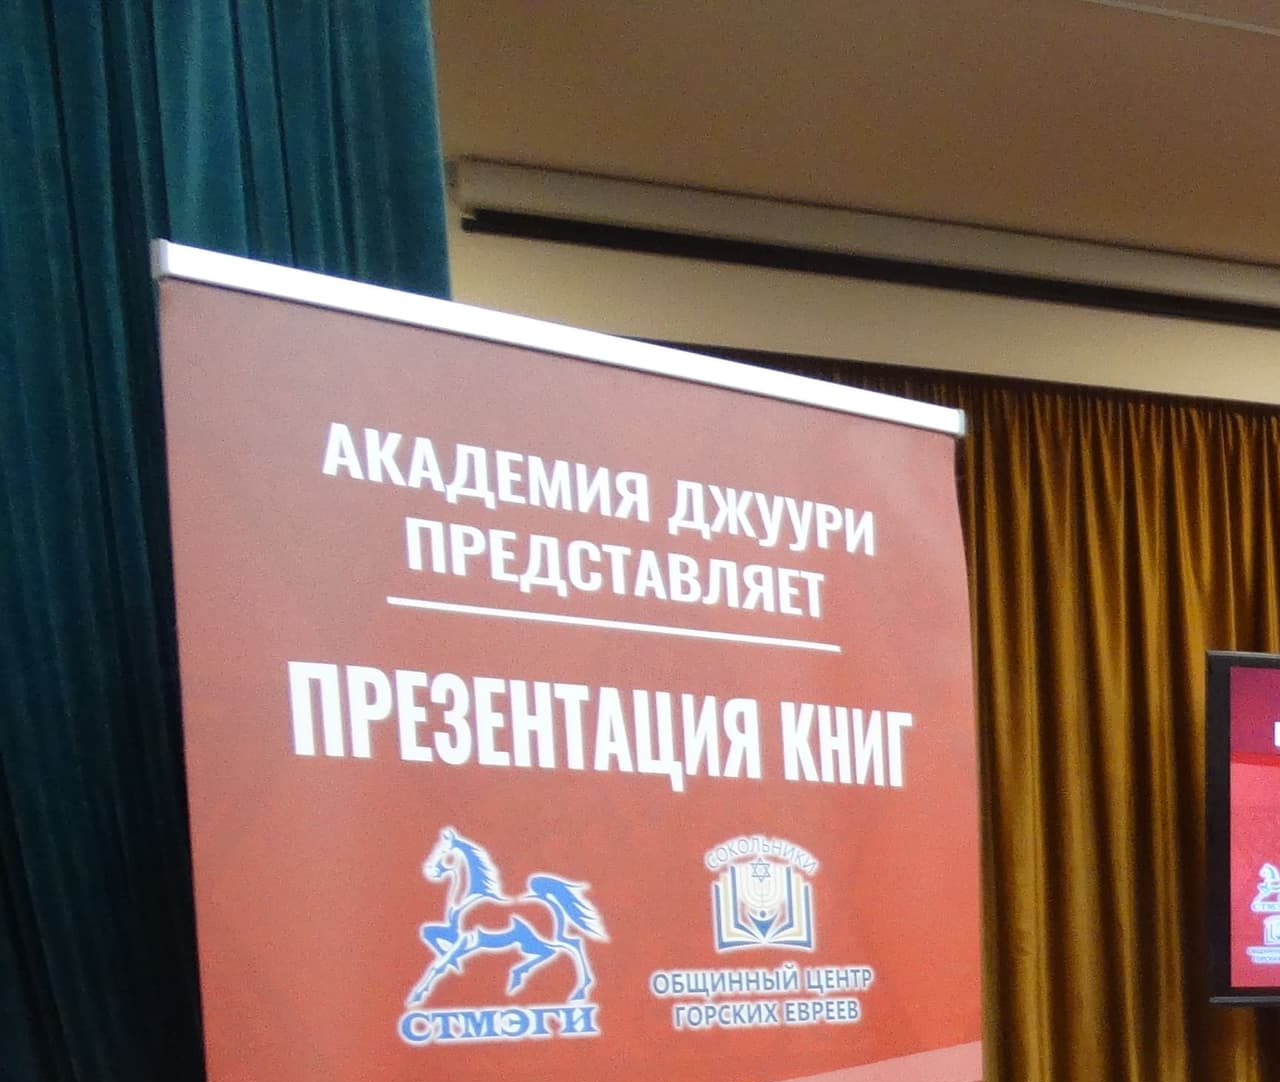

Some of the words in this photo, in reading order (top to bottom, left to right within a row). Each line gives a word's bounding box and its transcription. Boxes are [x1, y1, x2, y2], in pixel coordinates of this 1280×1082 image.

[322, 421, 650, 523] АКАДЕМИЯ
[669, 480, 876, 557] ДЖУУРИ
[404, 515, 825, 619] ПРЕДСТАВЛЯЕТ
[287, 660, 760, 791] ПРЕЗЕНТАЦИЯ
[780, 701, 913, 788] КНИГ
[705, 836, 818, 875] СОКОЛЬНИКИ
[652, 964, 798, 996] ОБЩИННЫЙ
[806, 967, 873, 994] ЦЕНТР
[400, 1006, 599, 1042] СТМЭГИ
[674, 1001, 779, 1028] ГОРСКИХ
[785, 999, 859, 1022] ЕВРЕЕВ
